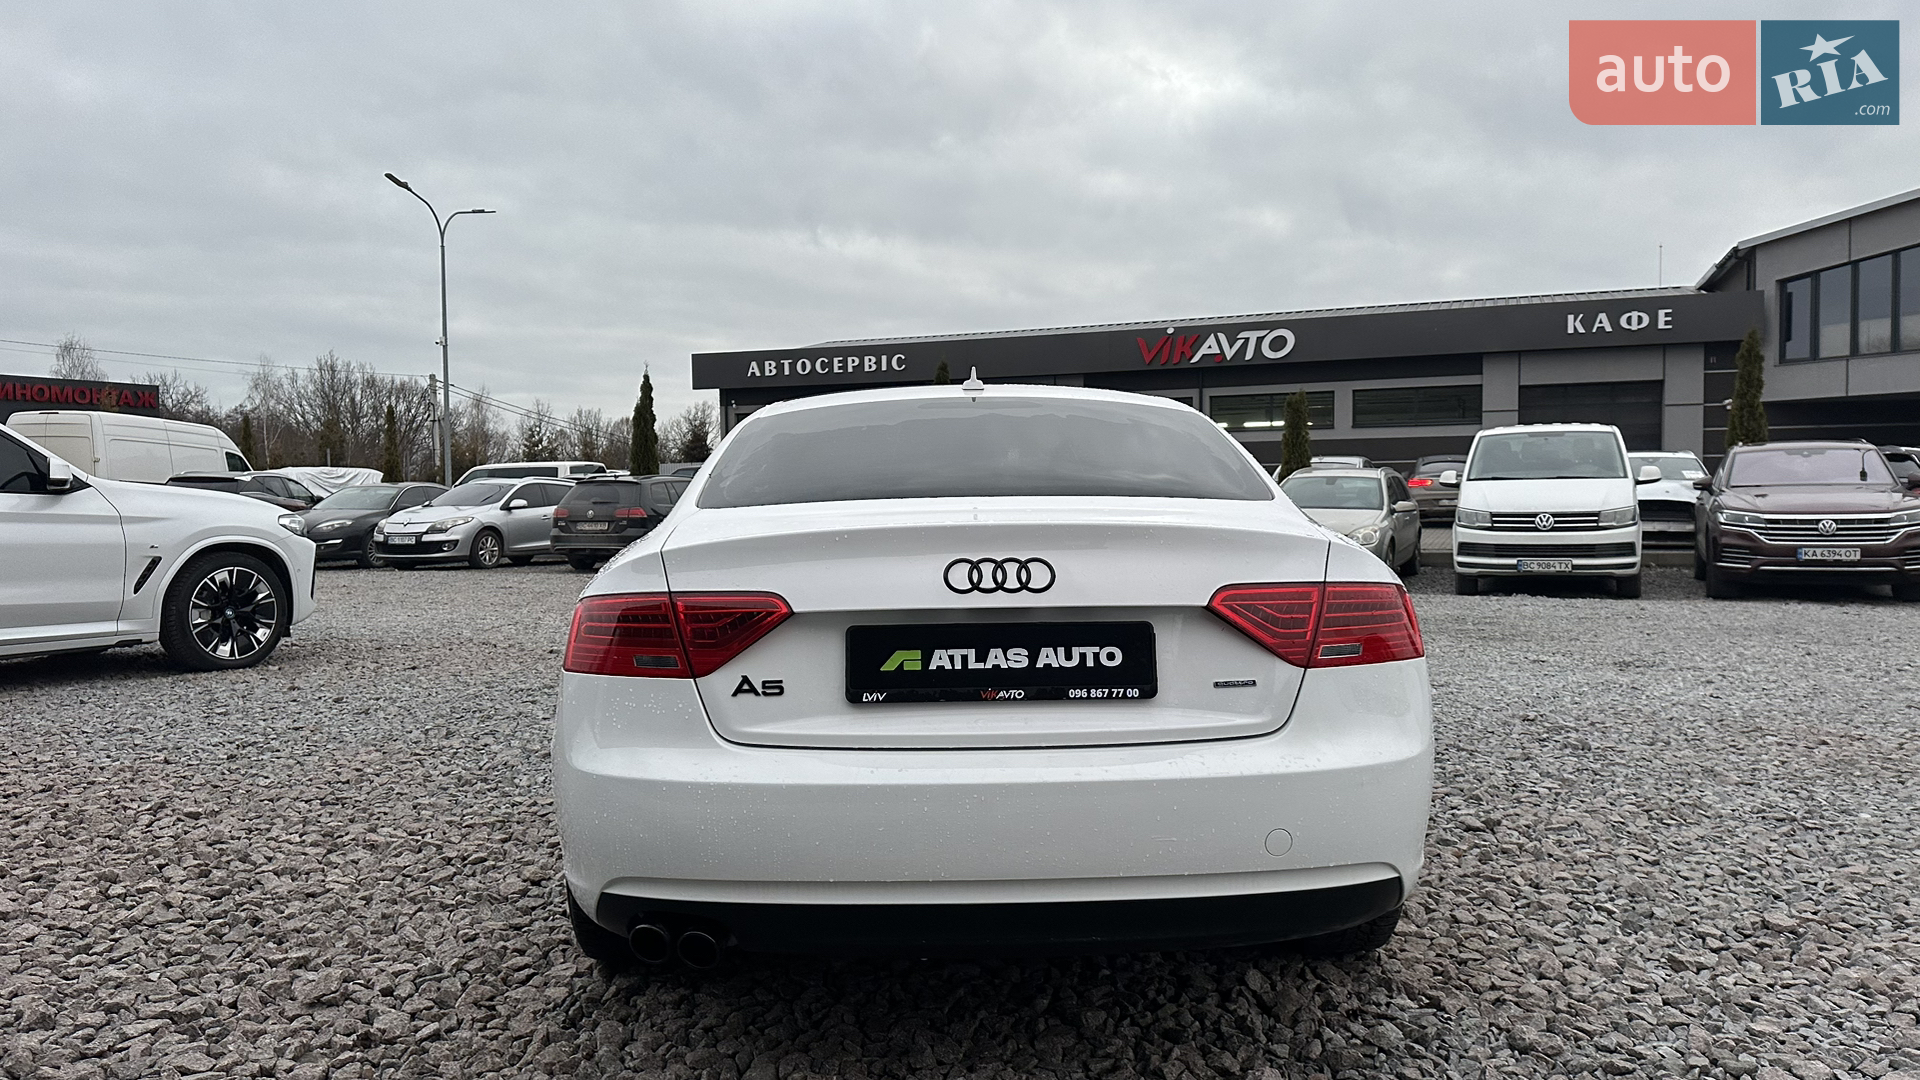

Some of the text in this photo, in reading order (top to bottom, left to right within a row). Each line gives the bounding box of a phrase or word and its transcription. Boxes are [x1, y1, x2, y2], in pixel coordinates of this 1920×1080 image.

[1567, 308, 1673, 334] КАФЕ
[747, 354, 906, 377] АВТОСЕРВІС
[1803, 549, 1860, 558] KA 6394 OT
[1522, 561, 1571, 570] BC 9084 TX
[928, 646, 1123, 670] ATLAS AUTO
[730, 674, 785, 698] A5
[1068, 688, 1140, 698] 096 867 77 00
